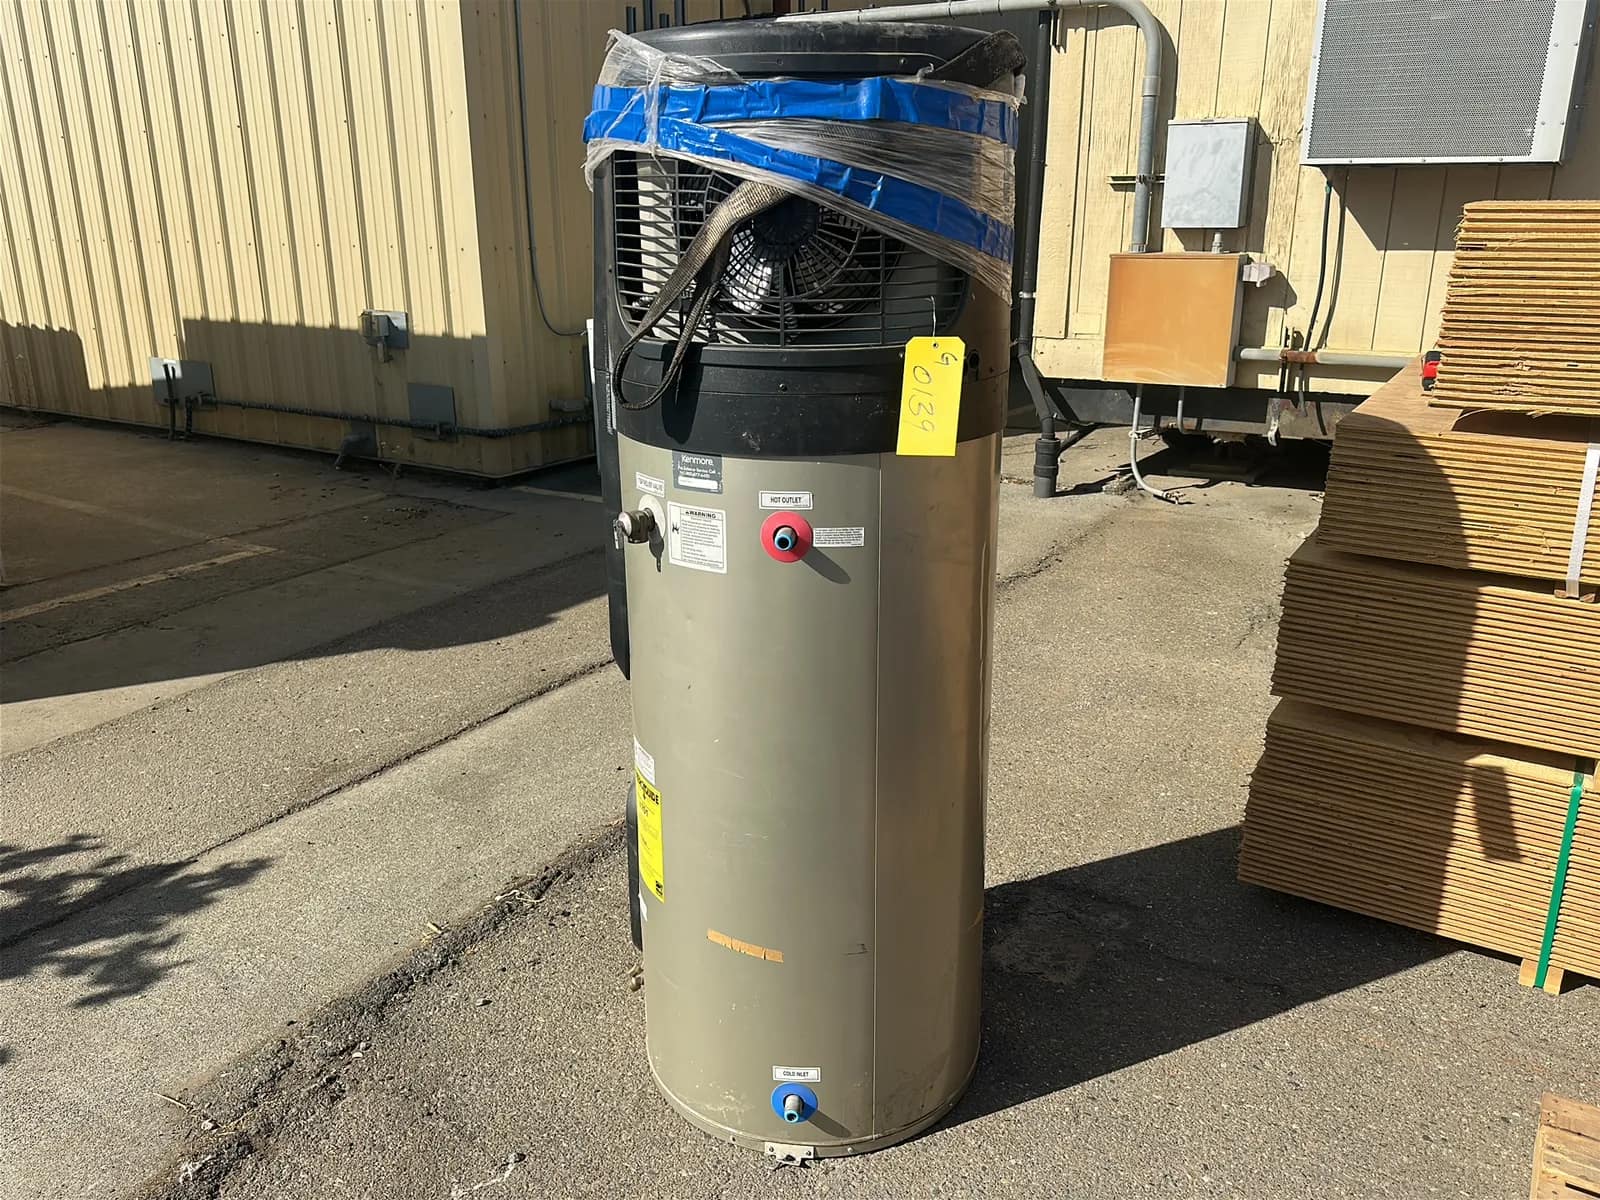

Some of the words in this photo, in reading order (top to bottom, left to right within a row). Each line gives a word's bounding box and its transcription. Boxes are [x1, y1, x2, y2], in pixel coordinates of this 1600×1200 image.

[905, 365, 935, 433] 0139
[681, 454, 714, 466] Kenmore
[770, 496, 781, 504] HOT
[781, 496, 802, 504] OUTLET
[689, 510, 717, 519] WARNING
